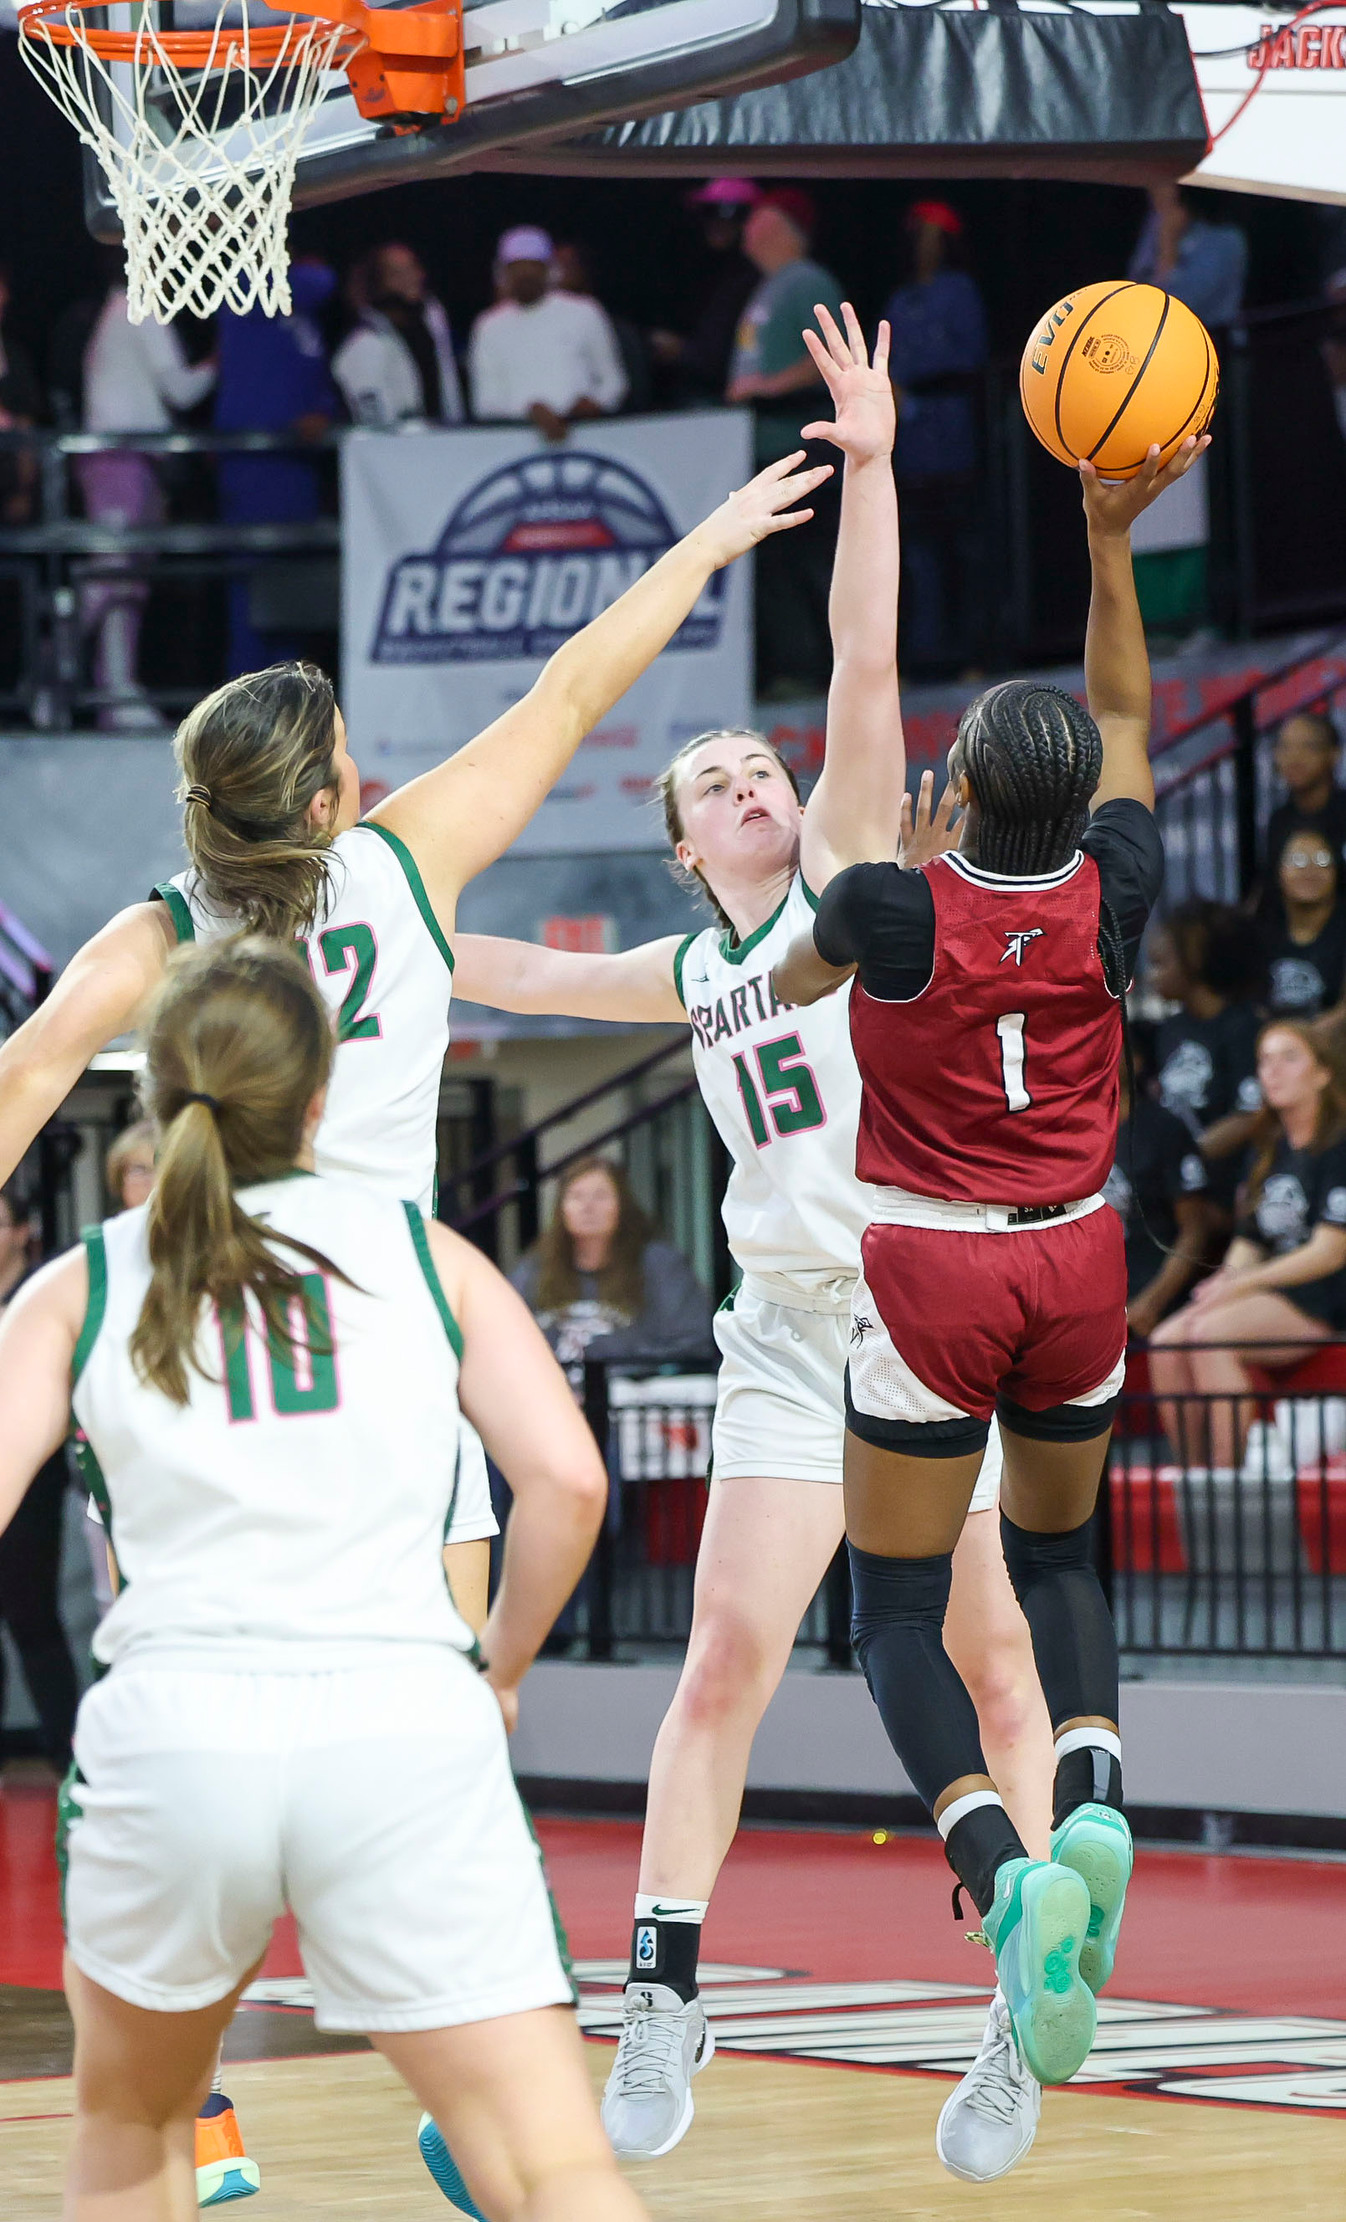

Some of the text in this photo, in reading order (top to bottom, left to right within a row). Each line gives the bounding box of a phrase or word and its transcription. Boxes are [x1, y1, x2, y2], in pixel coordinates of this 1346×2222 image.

[1246, 24, 1346, 69] JACK
[1030, 301, 1075, 376] EVO
[387, 554, 715, 635] REGION
[295, 920, 383, 1044] 2
[690, 969, 838, 1051] SPARTA
[730, 1030, 828, 1151] 15
[996, 1011, 1033, 1114] 1
[212, 1268, 343, 1427] 10
